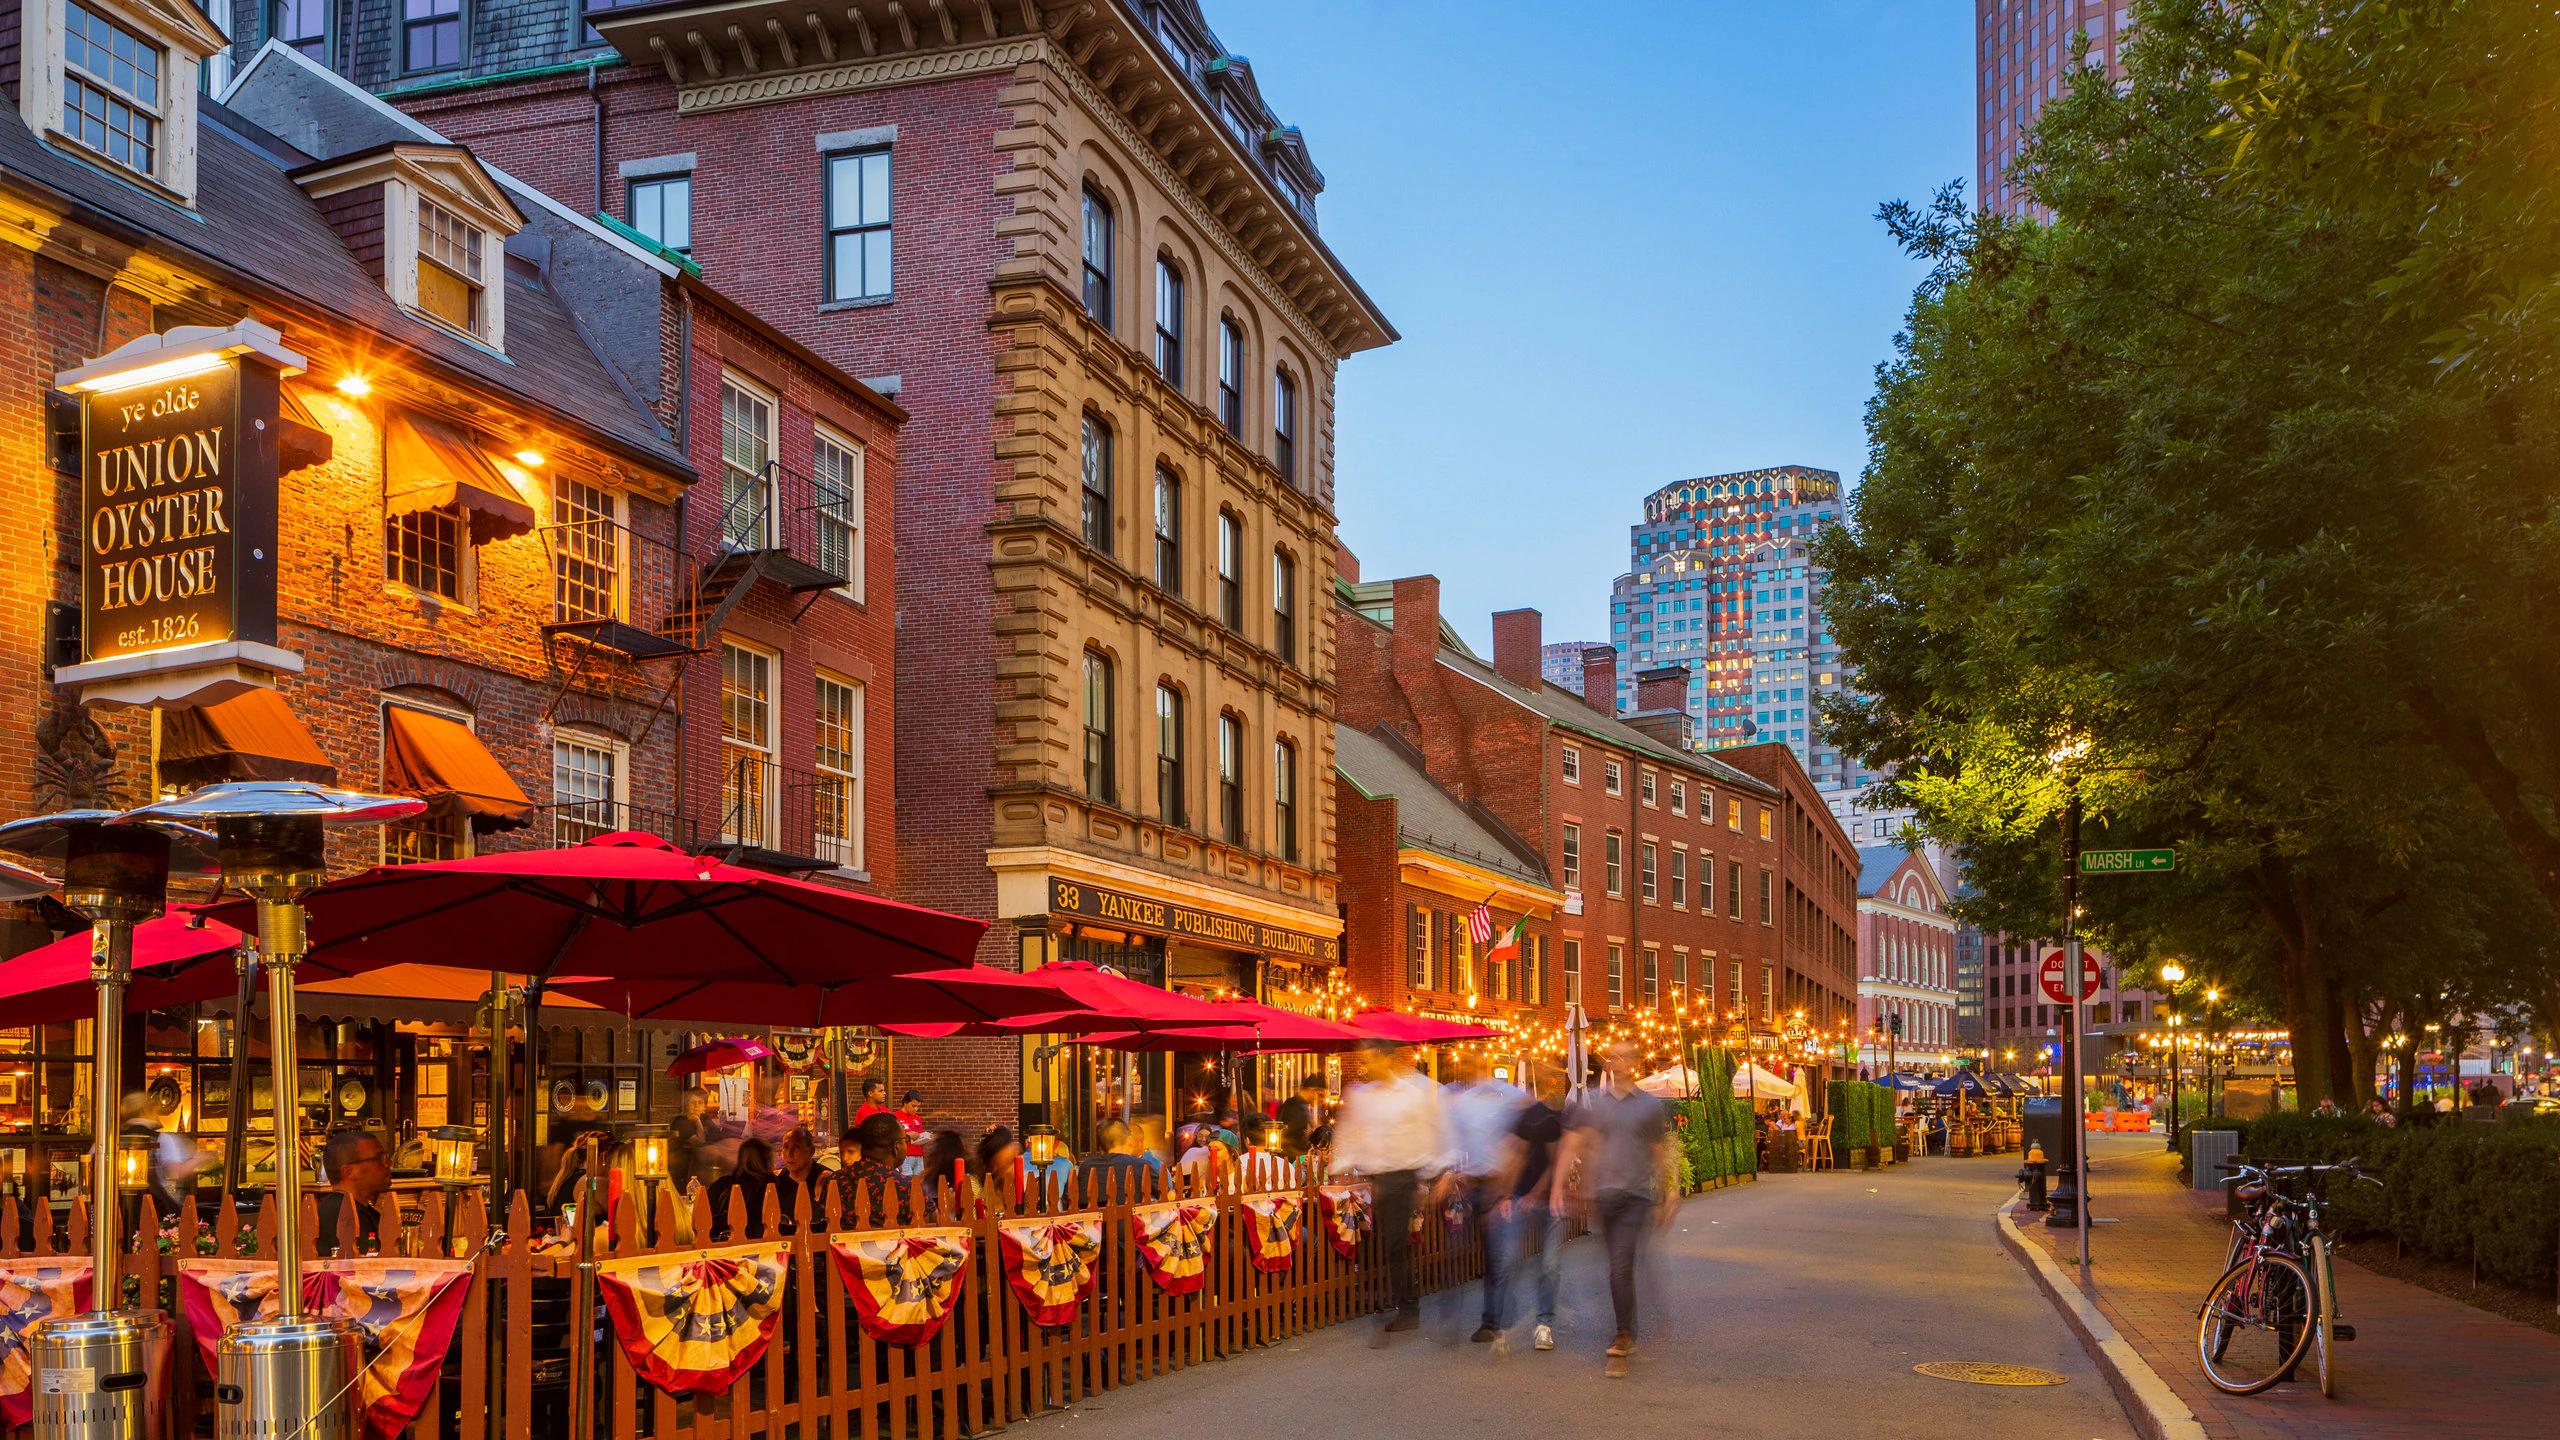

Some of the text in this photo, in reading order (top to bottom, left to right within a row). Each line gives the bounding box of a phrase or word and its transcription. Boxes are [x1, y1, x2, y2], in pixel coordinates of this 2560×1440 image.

[120, 383, 200, 433] ye olde
[97, 426, 223, 497] UNION
[92, 486, 231, 555] OYSTER
[100, 546, 217, 611] HOUSE
[2086, 852, 2145, 869] MARSH LN
[1057, 883, 1337, 960] 33 YANKEE PUBLISHING BUILDING 33
[2051, 960, 2064, 969] DO
